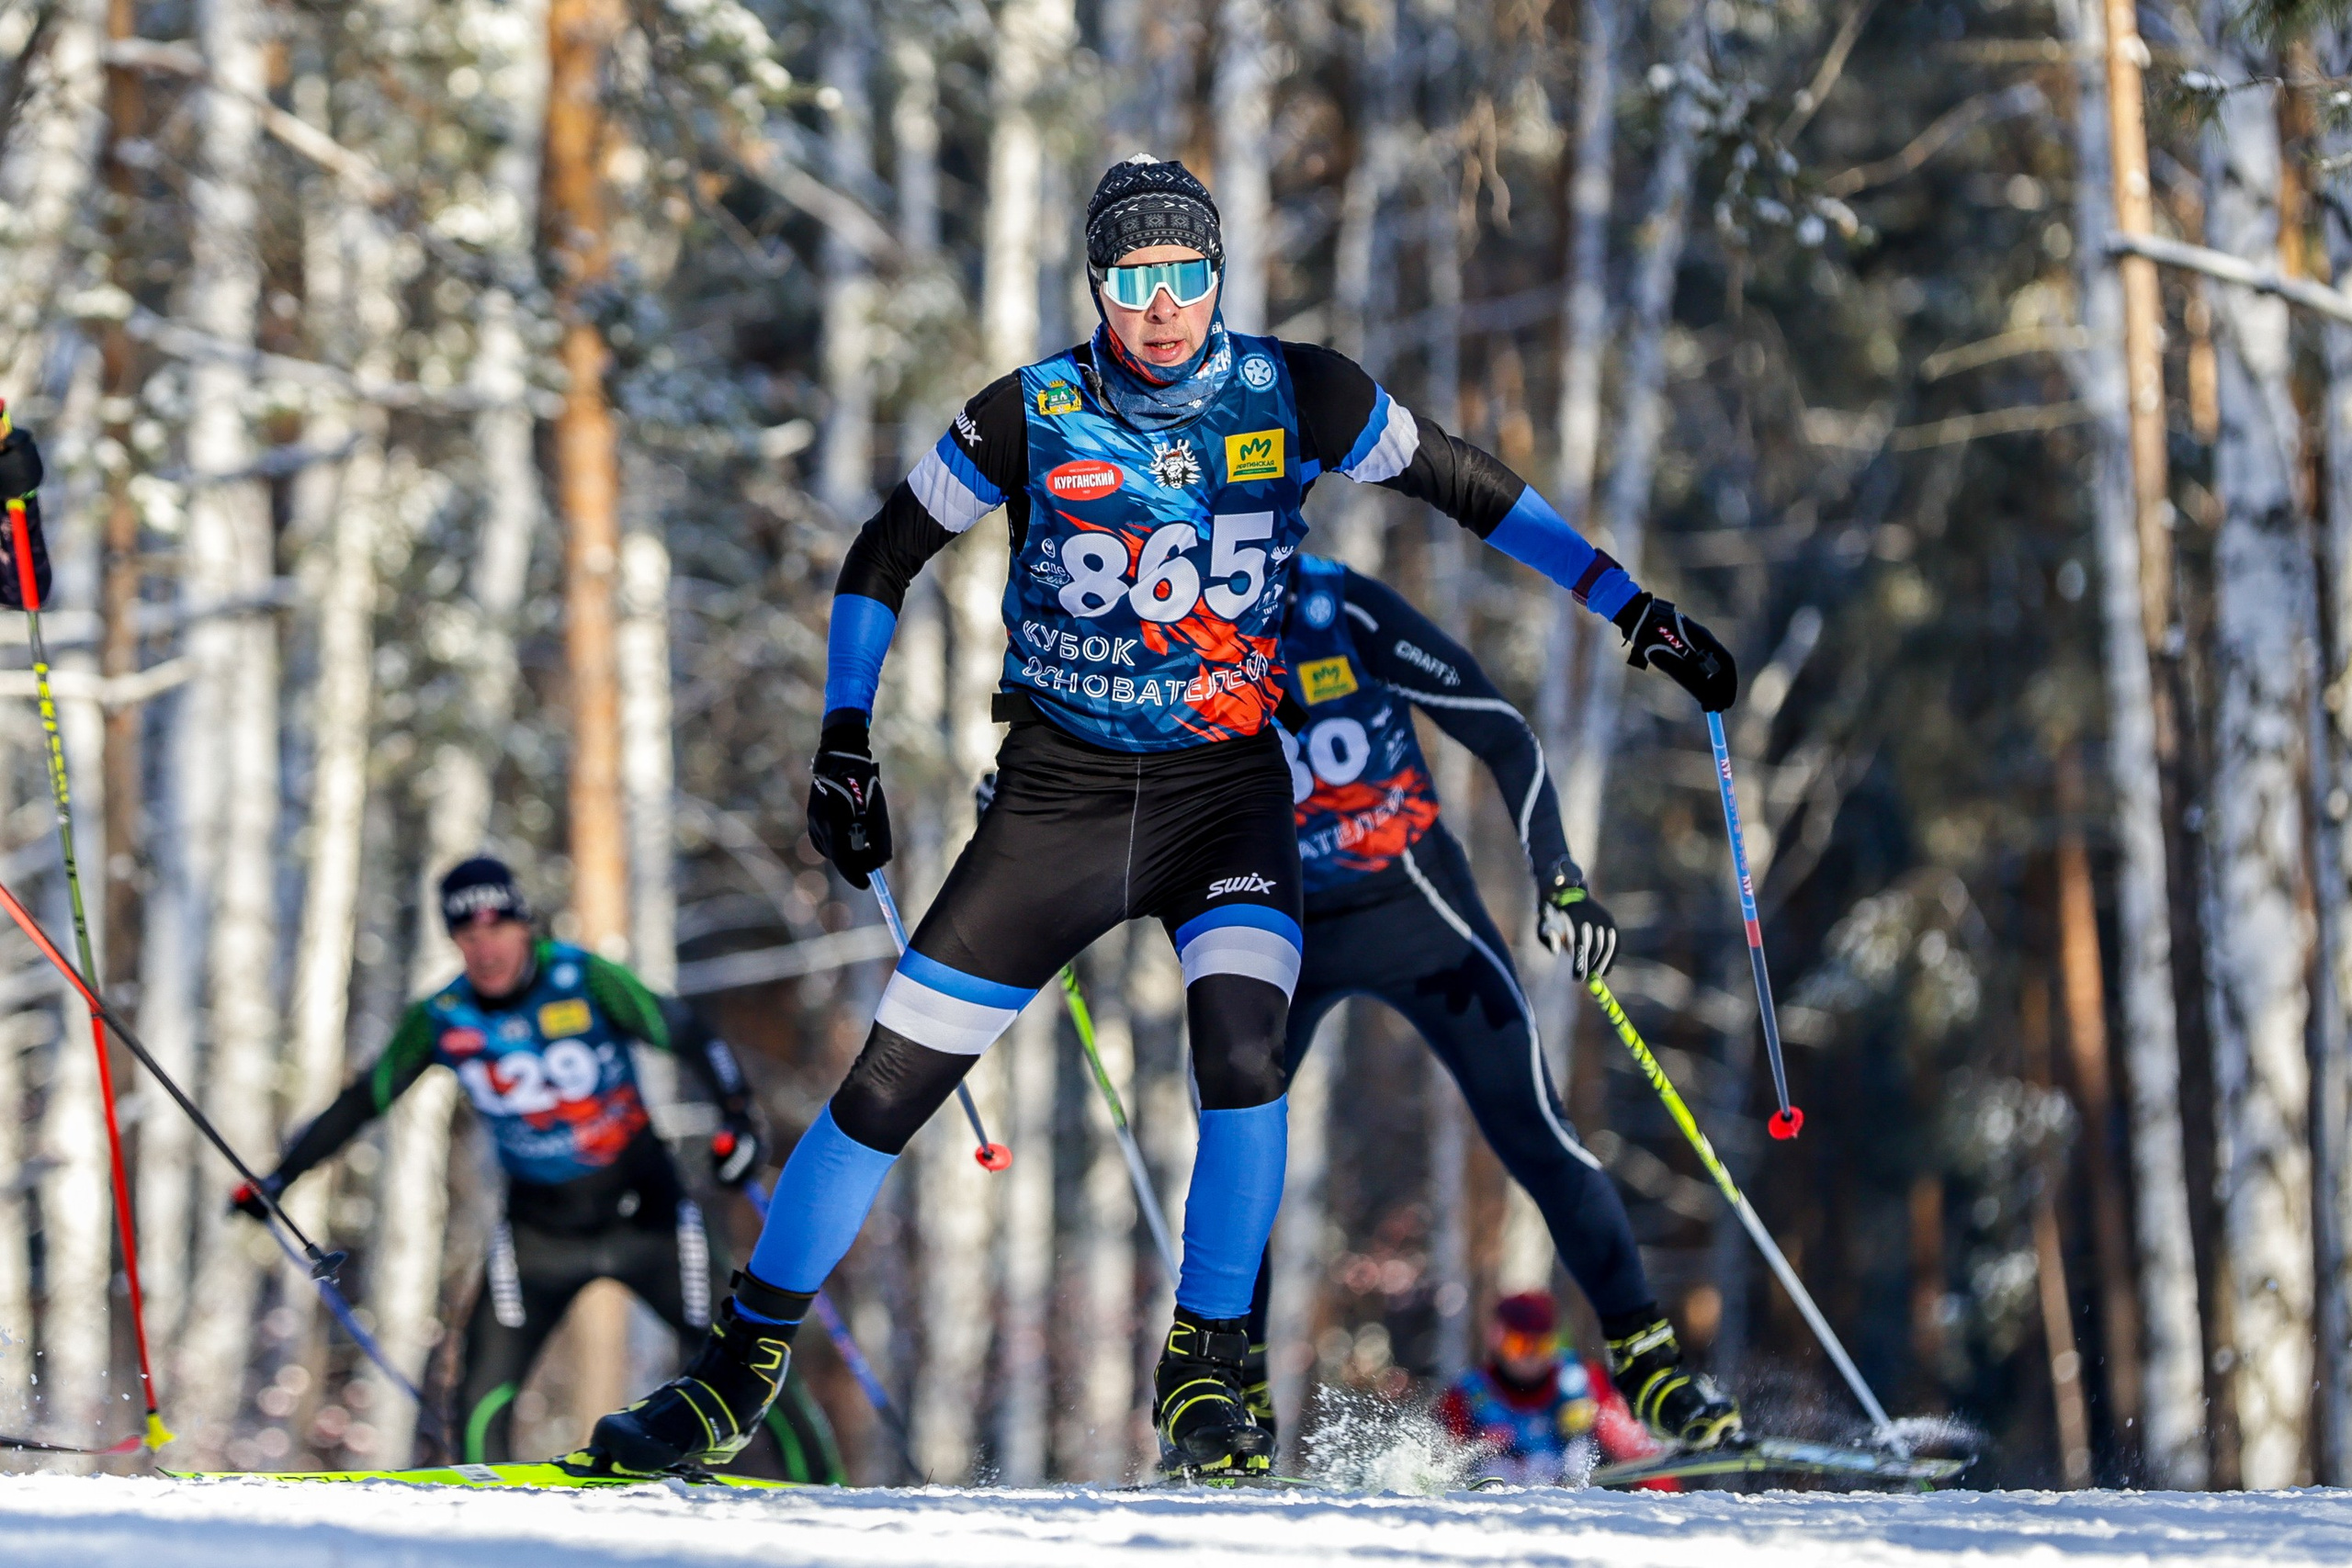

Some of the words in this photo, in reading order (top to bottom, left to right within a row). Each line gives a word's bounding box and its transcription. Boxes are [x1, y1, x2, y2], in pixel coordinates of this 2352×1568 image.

[1054, 468, 1115, 490] КУРГАНСКИЙ
[1058, 511, 1275, 624] 865
[1023, 620, 1138, 667] КУБОК
[1396, 639, 1449, 678] CRAFT
[1022, 650, 1269, 706] ОСНОВАТЕЛЕЙ
